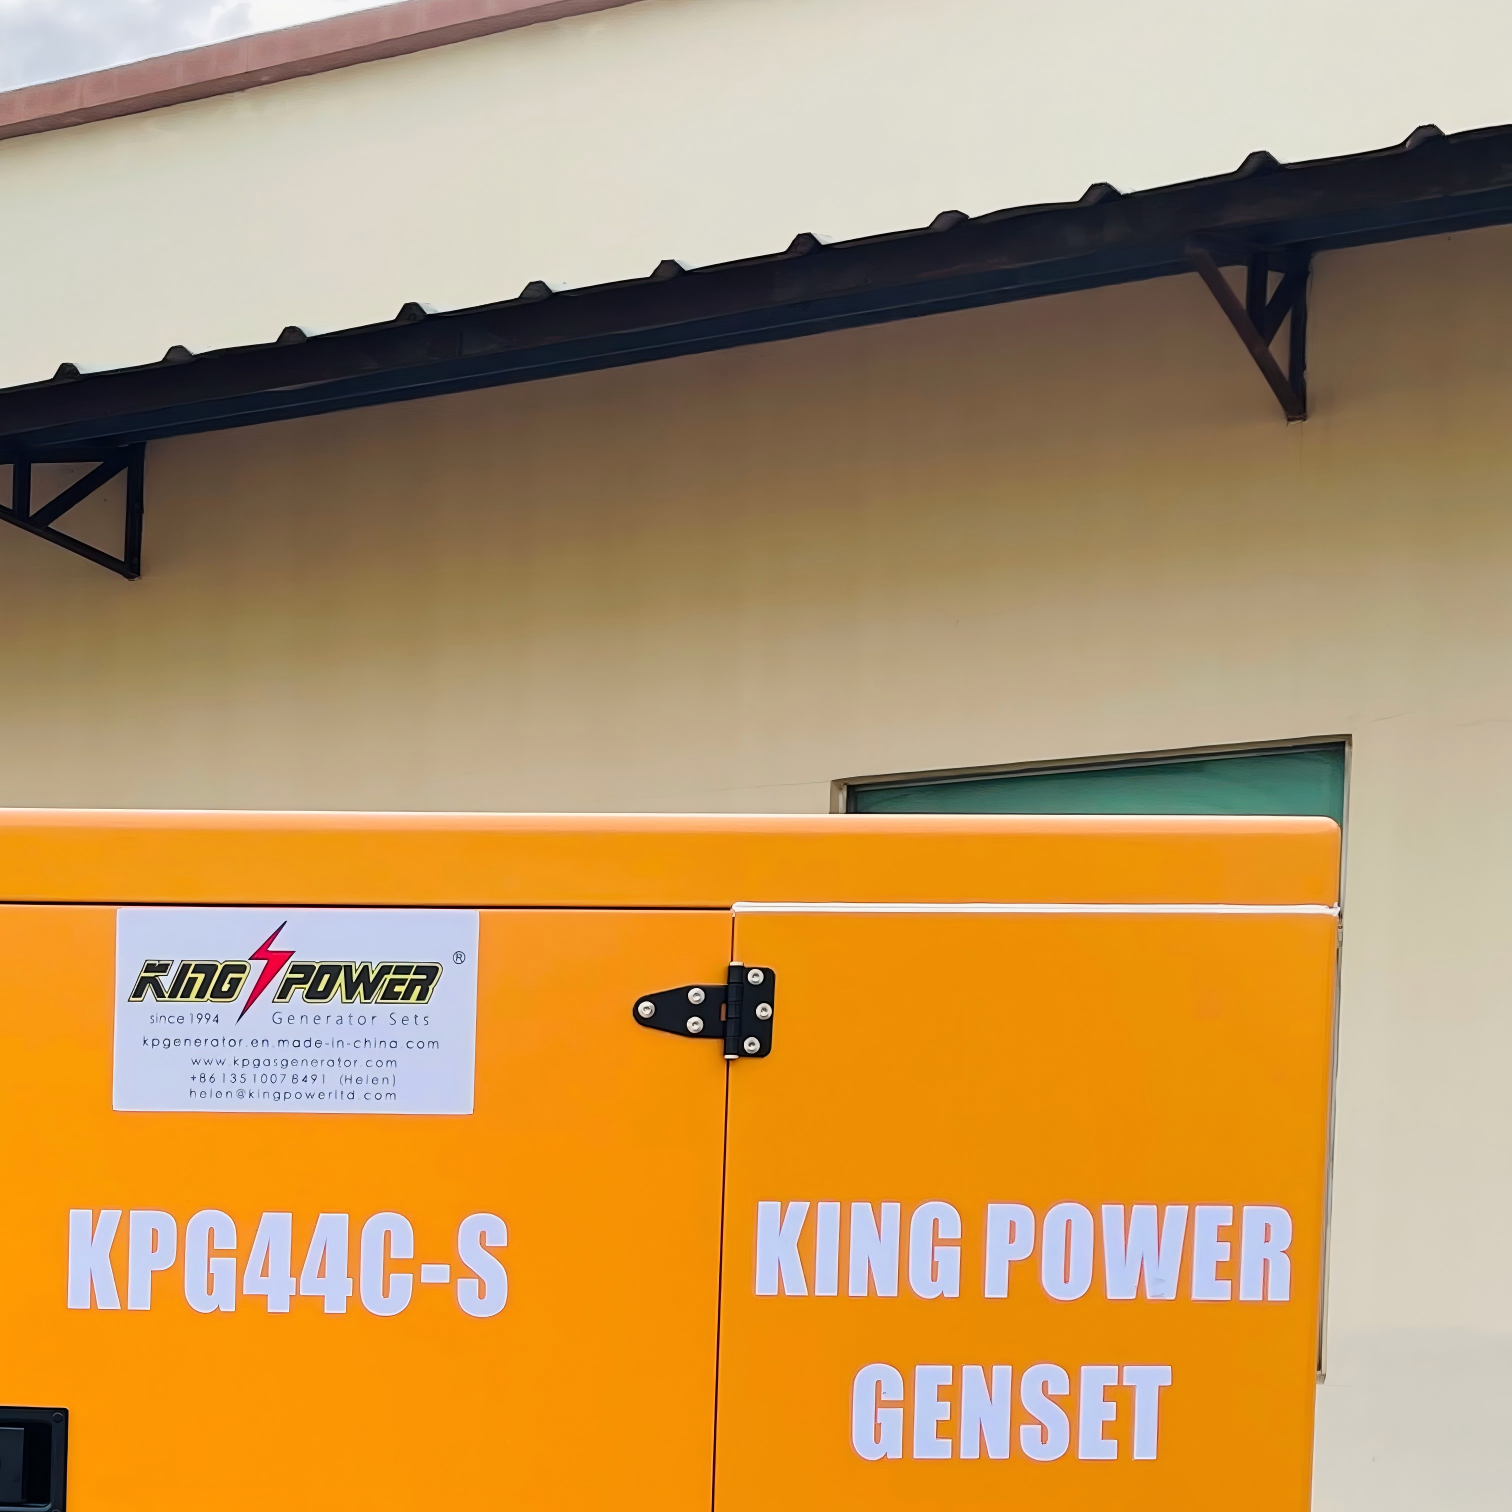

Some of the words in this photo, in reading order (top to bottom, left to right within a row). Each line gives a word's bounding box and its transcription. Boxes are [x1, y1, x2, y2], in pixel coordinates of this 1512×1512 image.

[128, 959, 251, 1003] KING
[272, 961, 444, 1004] POWER
[149, 1012, 185, 1025] since
[190, 1012, 219, 1025] 1994
[271, 1011, 378, 1026] Generator
[389, 1011, 429, 1026] Sets
[339, 1073, 396, 1088] (Helen)
[67, 1208, 508, 1318] KPG44C-S
[755, 1200, 962, 1300] KING
[984, 1202, 1293, 1302] POWER
[851, 1362, 1172, 1462] GENSET
